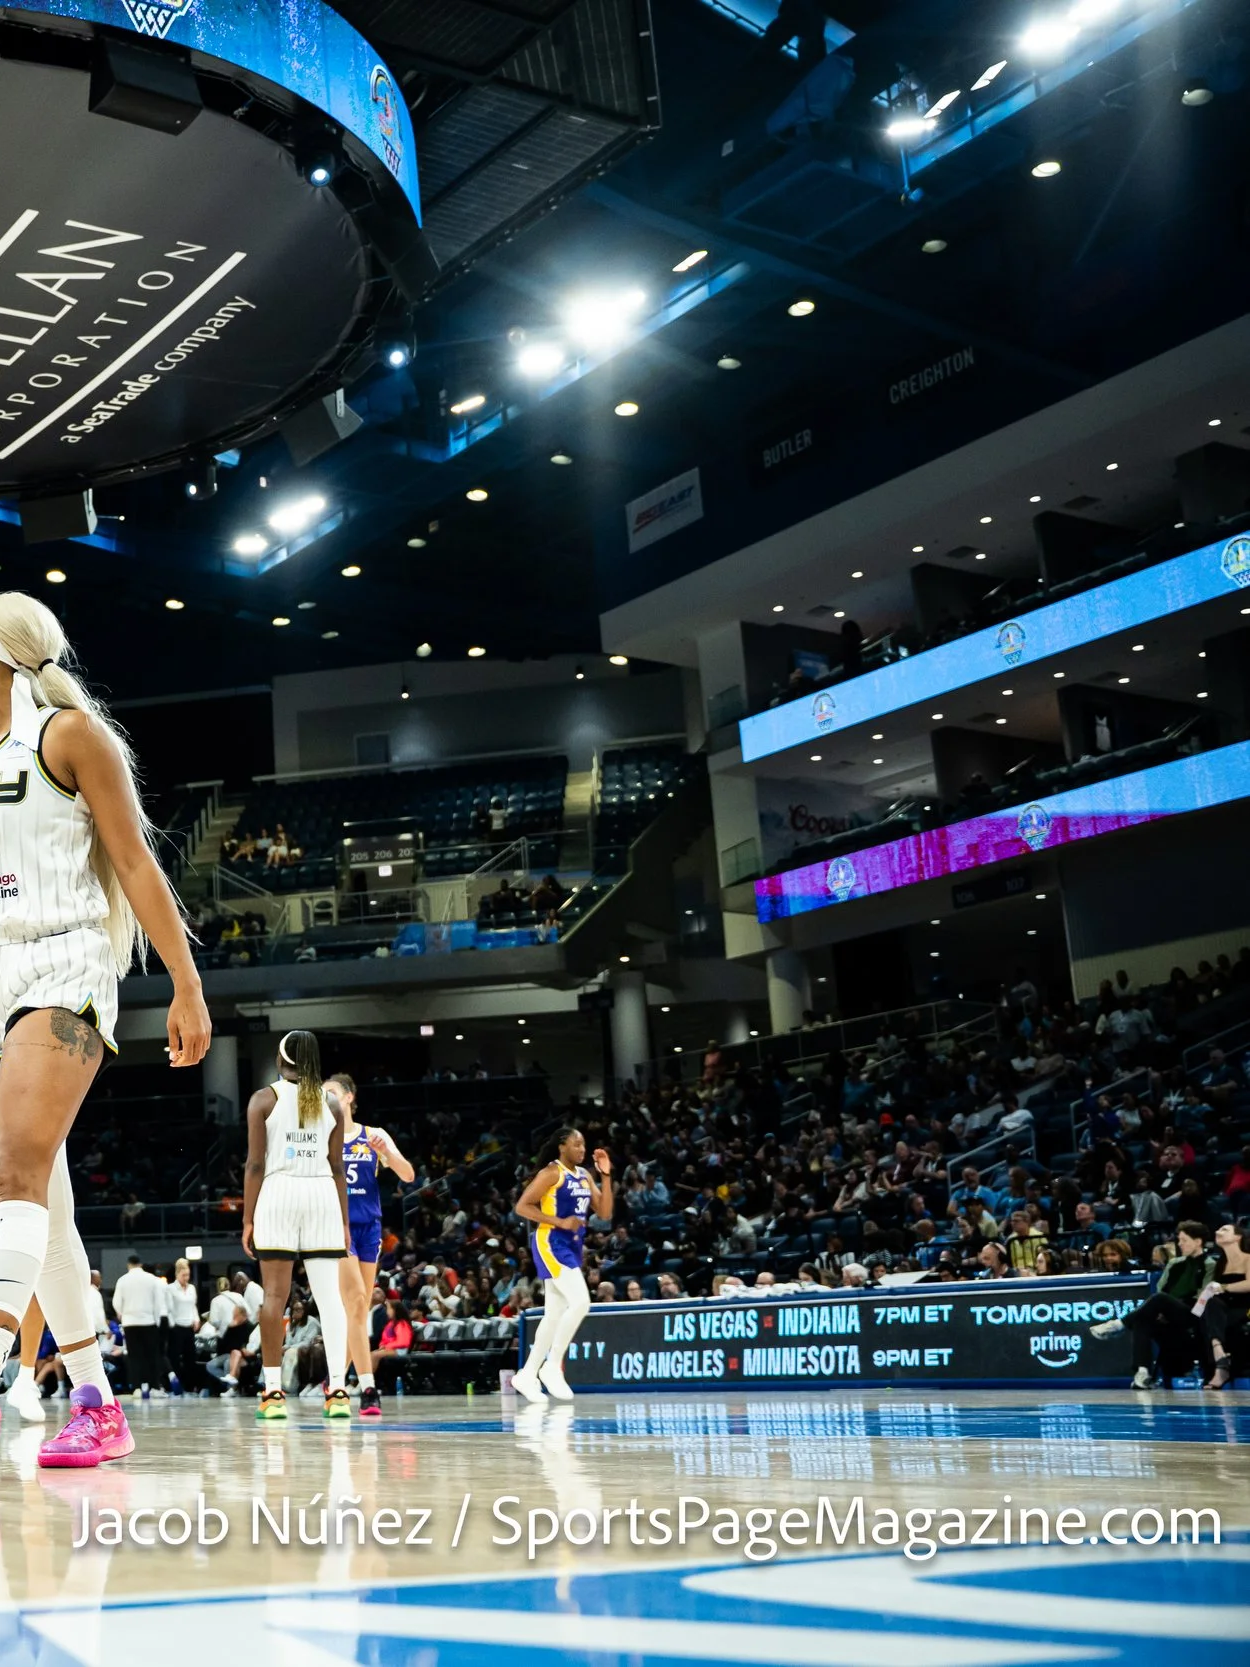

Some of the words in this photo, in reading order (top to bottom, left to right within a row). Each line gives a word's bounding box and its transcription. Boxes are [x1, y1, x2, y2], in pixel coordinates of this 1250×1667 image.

[153, 295, 257, 372] company
[888, 345, 975, 405] CREIGHTON
[70, 372, 160, 434] SeaTrade
[60, 433, 82, 443] a
[762, 428, 813, 470] BUTLER
[374, 850, 393, 860] 206
[286, 1132, 317, 1144] WILLIAMS
[296, 1150, 317, 1158] AT&T
[575, 1197, 590, 1214] 30
[663, 1312, 697, 1342] LAS
[699, 1309, 759, 1340] VEGAS
[778, 1304, 861, 1336] INDIANA
[873, 1306, 921, 1326] 7PM
[924, 1304, 953, 1323] ET
[970, 1299, 1145, 1326] TOMORROW
[1030, 1331, 1082, 1355] prime
[612, 1352, 644, 1380] LOS
[646, 1349, 724, 1379] ANGELES
[742, 1345, 861, 1376] MINNESOTA
[872, 1349, 921, 1367] 9PM
[924, 1348, 953, 1366] ET
